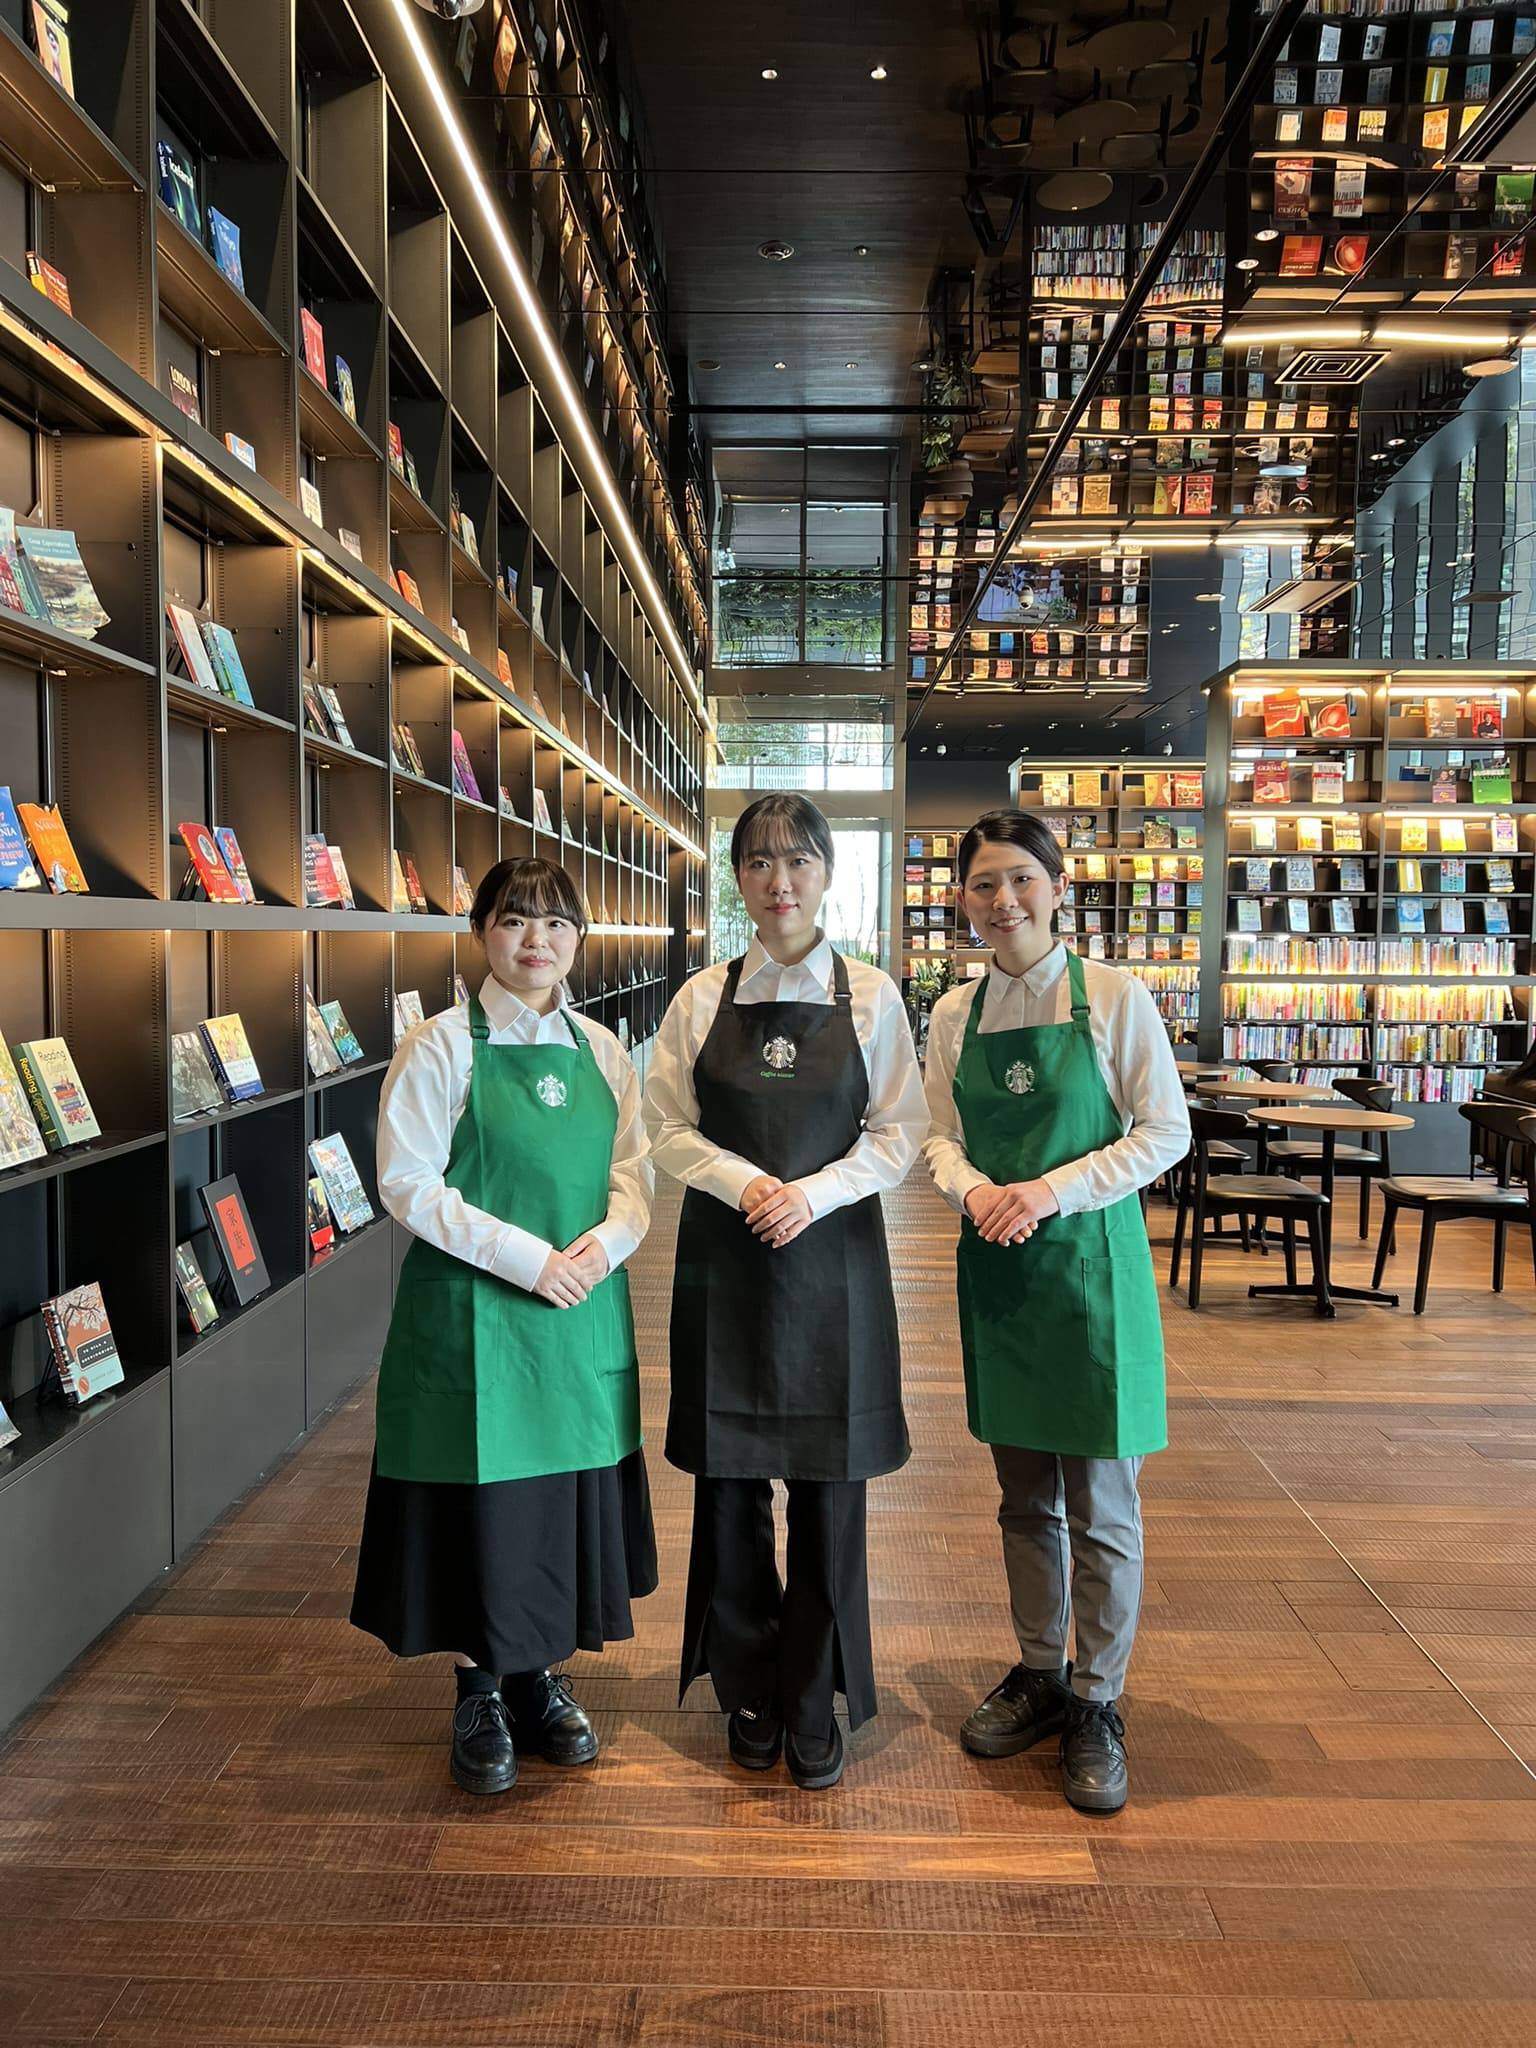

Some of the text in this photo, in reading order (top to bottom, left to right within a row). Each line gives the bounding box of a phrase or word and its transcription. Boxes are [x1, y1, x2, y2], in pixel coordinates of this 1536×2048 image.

[168, 157, 194, 189] Iceland
[169, 365, 192, 396] LONDON
[38, 1049, 67, 1062] Reading
[19, 1057, 38, 1094] Reading
